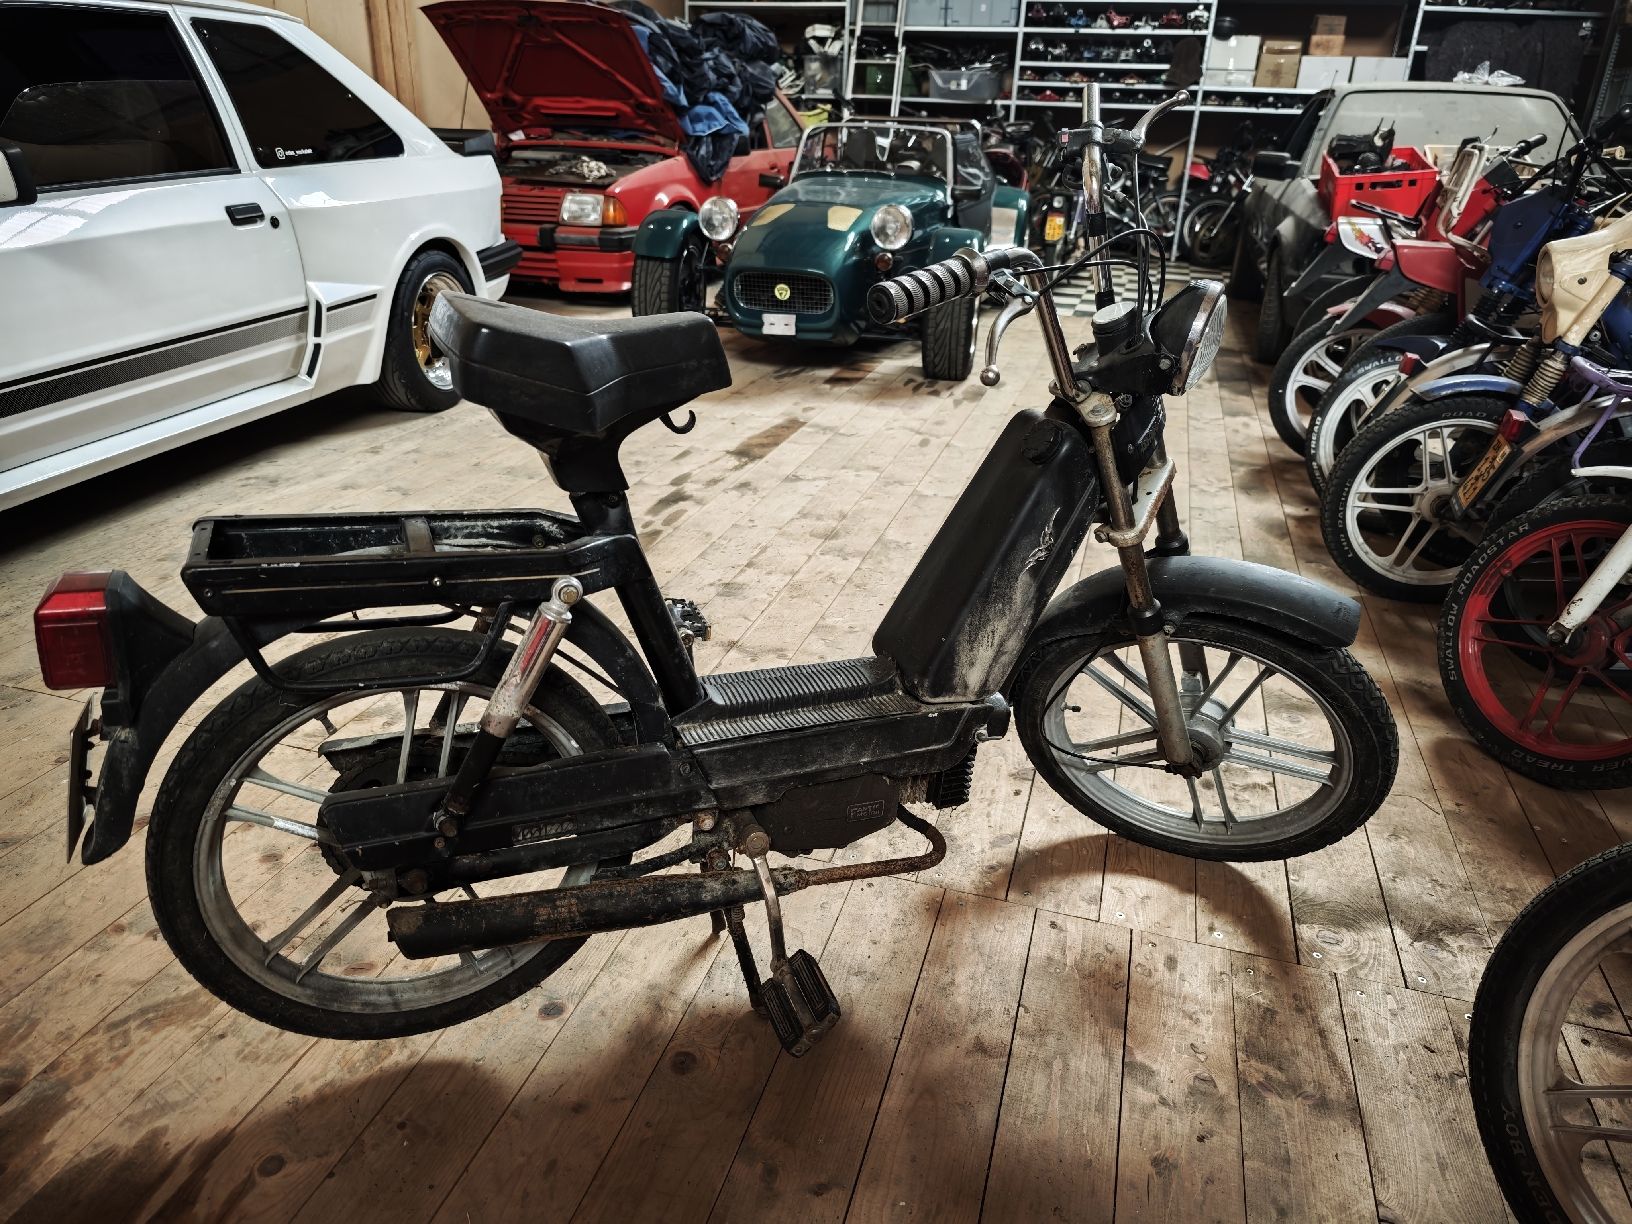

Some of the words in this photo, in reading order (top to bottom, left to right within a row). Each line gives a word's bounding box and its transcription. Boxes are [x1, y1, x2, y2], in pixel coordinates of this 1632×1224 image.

[1356, 355, 1404, 373] SWALLO
[1310, 416, 1323, 455] TREAD
[1446, 602, 1458, 681] SWALLOW
[1457, 523, 1529, 595] ROADSTAR
[1511, 749, 1576, 773] TREAD
